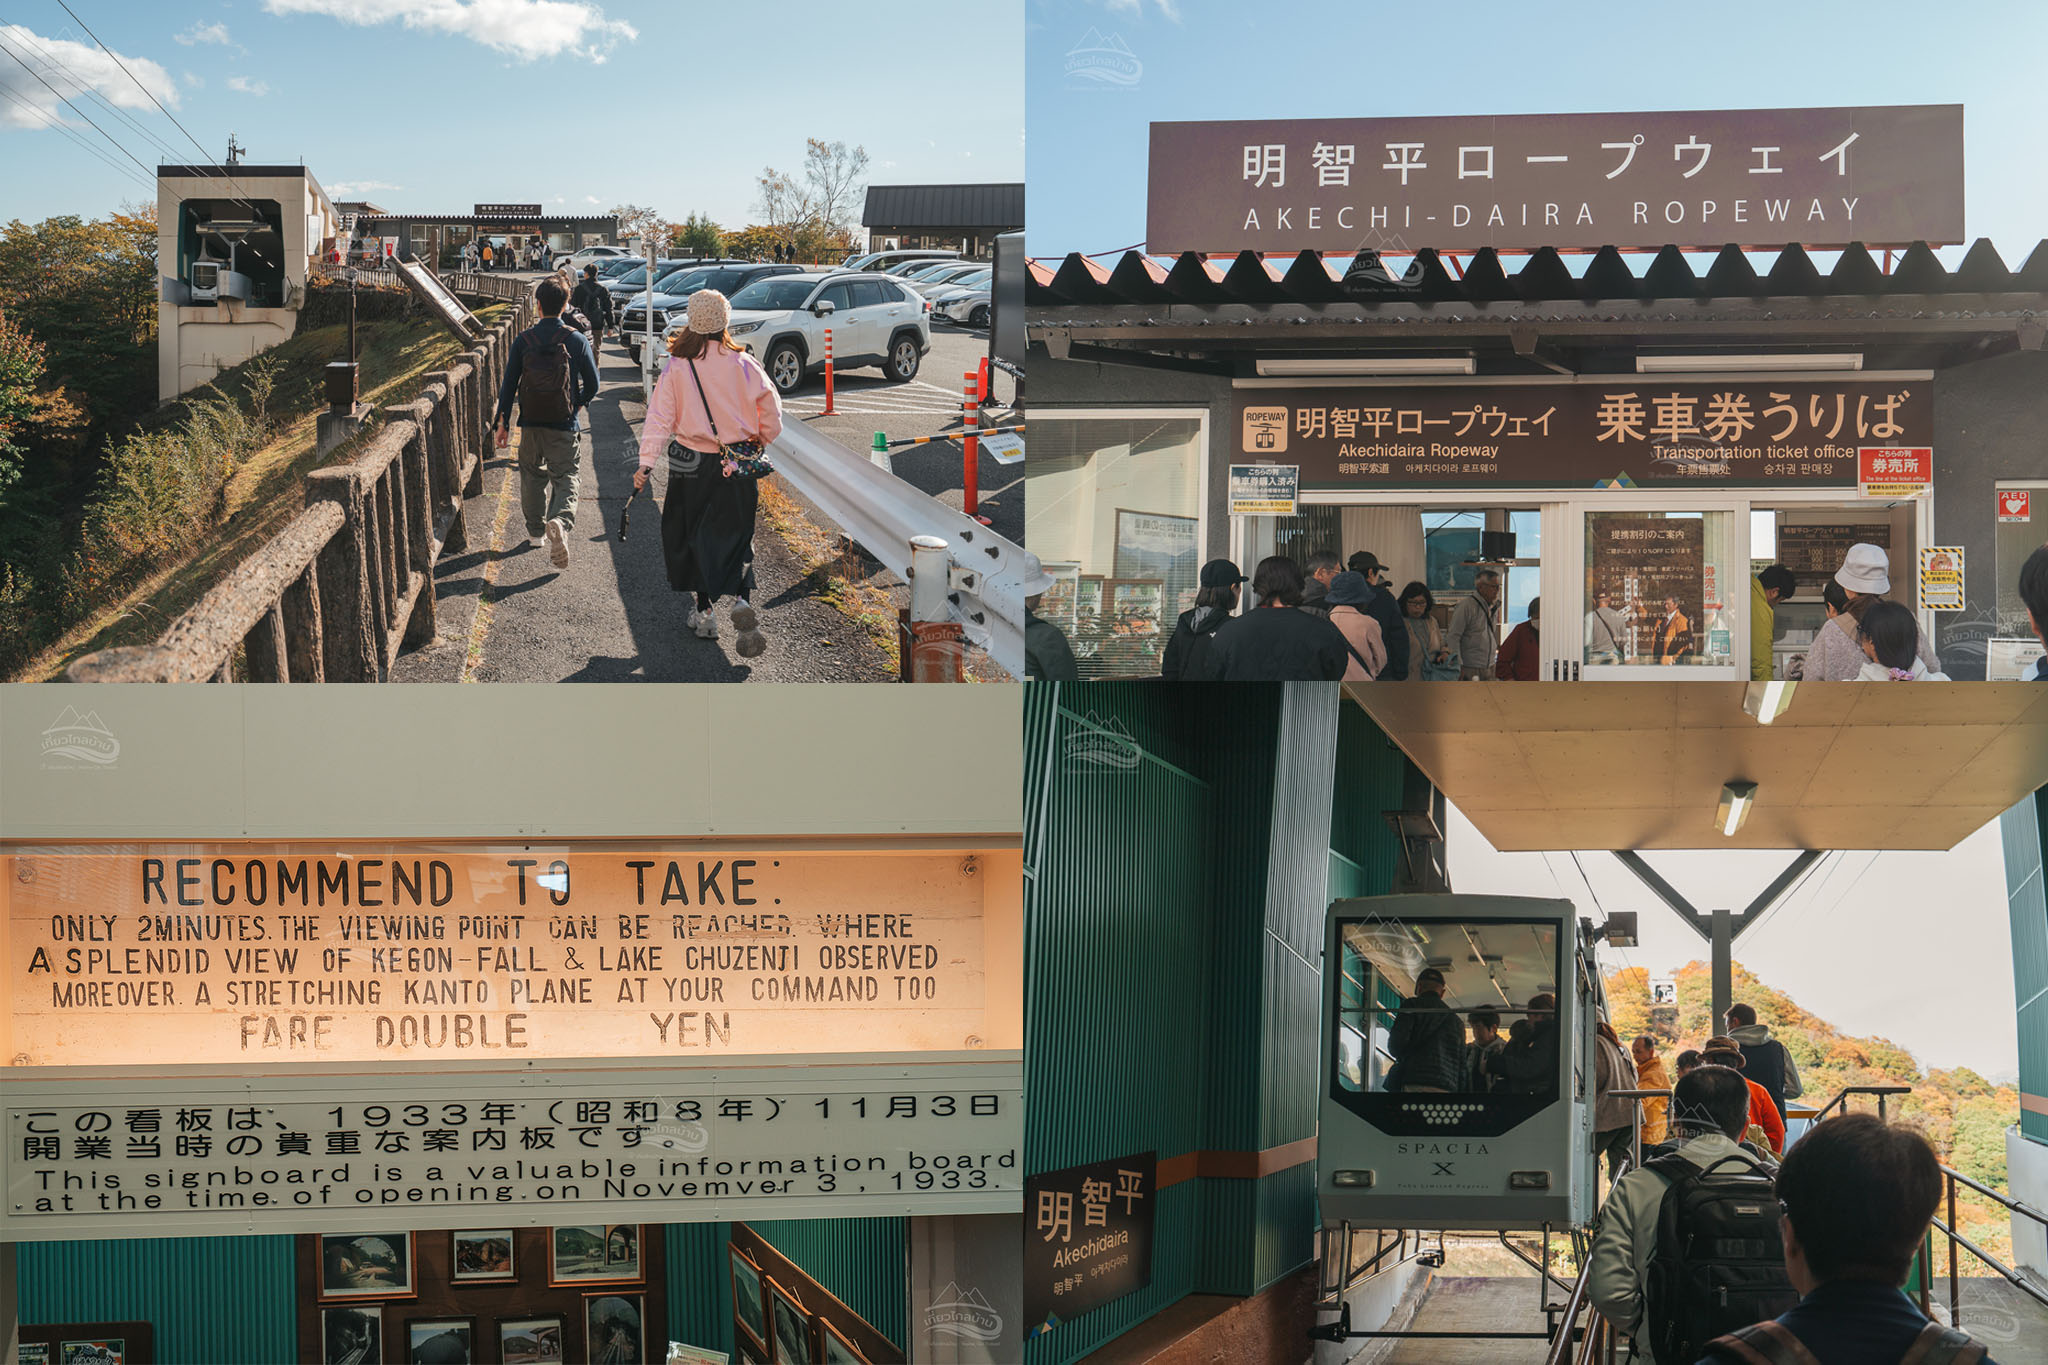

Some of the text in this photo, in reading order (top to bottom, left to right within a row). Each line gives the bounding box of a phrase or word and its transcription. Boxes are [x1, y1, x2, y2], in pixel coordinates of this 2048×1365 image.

[1242, 131, 1863, 188] 明智平ロープウェイ
[1243, 196, 1861, 231] AKECHI-DAIRA ROPEWAY
[1246, 411, 1286, 422] ROPEWAY
[1295, 405, 1558, 439] 明智平ロープウェイ
[1596, 389, 1911, 443] 乗車券うりば
[1339, 443, 1499, 459] Akechidaira Ropeway
[1653, 445, 1761, 460] Transportation
[1766, 445, 1809, 459] ticket
[1814, 444, 1855, 459] office
[1872, 458, 1919, 473] 券売所
[1878, 450, 1913, 458] こちらの列
[1339, 463, 1390, 474] 明智平索道
[1405, 463, 1498, 474] 아케치다이라 로프웨이
[1763, 463, 1833, 475] 승차권 판매장
[2001, 492, 2027, 500] AED
[1611, 529, 1685, 540] 提携割引のご案内
[1704, 566, 1716, 601] 券売所
[143, 859, 453, 907] RECOMMEND
[507, 860, 571, 907] TO
[51, 915, 118, 942] ONLY
[338, 915, 445, 941] VIEWING
[459, 915, 526, 941] POINT
[550, 914, 598, 941] CAN
[618, 914, 652, 940] BE
[816, 913, 914, 940] WHERE
[28, 946, 52, 974] A
[65, 947, 211, 975] SPLENDID
[224, 947, 299, 975] VIEW
[322, 947, 352, 974] OF
[563, 946, 585, 971] &
[599, 946, 664, 972] LAKE
[685, 945, 800, 973] CHUZENJI
[818, 944, 939, 971] OBSERVED
[194, 981, 212, 1006] A
[227, 980, 382, 1007] STRETCHING
[404, 979, 489, 1006] KANTO
[510, 978, 593, 1005] PLANE
[617, 977, 650, 1004] AT
[662, 976, 724, 1004] YOUR
[751, 974, 879, 1003] COMMAND
[893, 975, 937, 1002] TOO
[239, 1011, 731, 1051] FARE DOUBLE YEN
[22, 1125, 675, 1161] 開業当時の貴重な案内板です。
[1398, 1143, 1489, 1155] SPACIA
[35, 1149, 1016, 1191] This signboard is a valuable information board
[1431, 1162, 1456, 1176] X
[35, 1194, 75, 1212] at
[98, 1190, 162, 1210] the
[187, 1189, 270, 1207] time
[293, 1185, 332, 1205] of
[355, 1183, 514, 1204] opening
[536, 1184, 580, 1200] on
[604, 1177, 795, 1198] Novemver
[891, 1168, 1001, 1192] 1933.
[1037, 1169, 1144, 1243] 明智平
[1053, 1229, 1129, 1268] Akechidaira
[1053, 1273, 1083, 1296] 明智平
